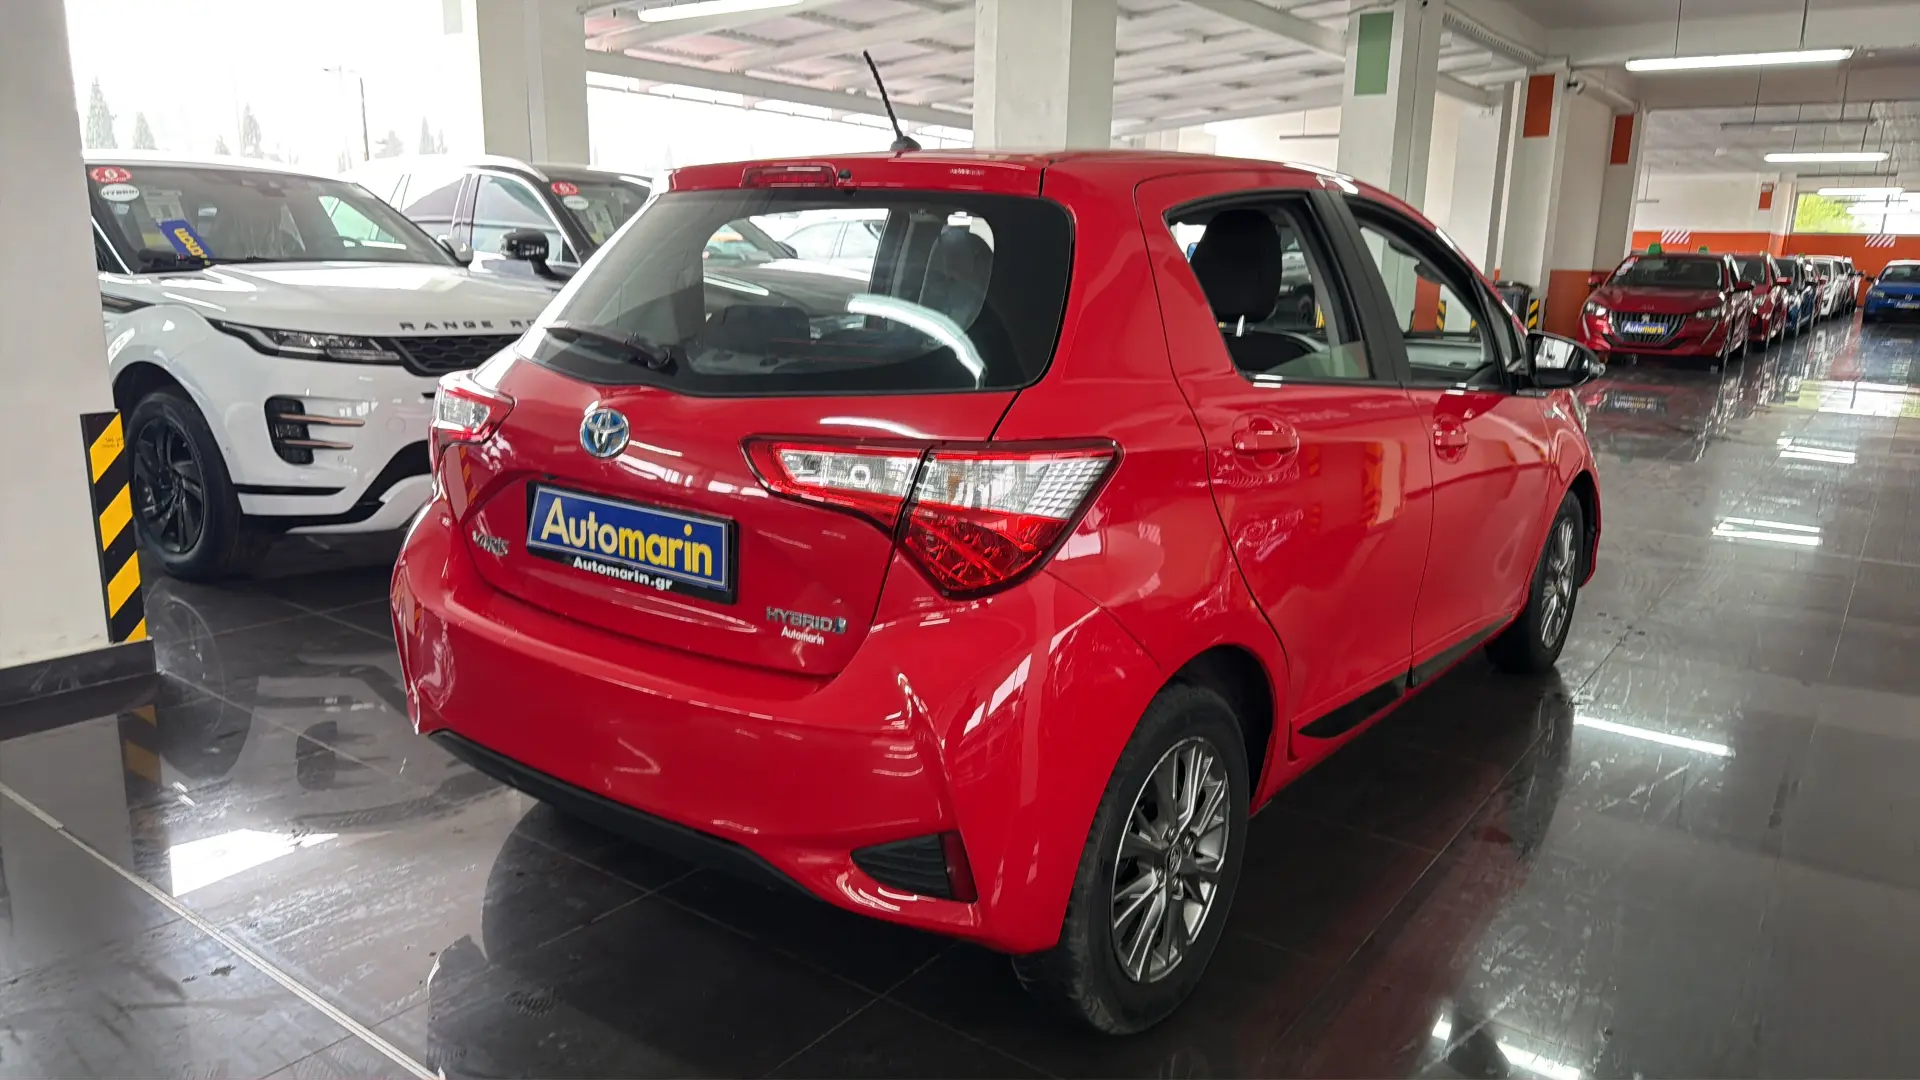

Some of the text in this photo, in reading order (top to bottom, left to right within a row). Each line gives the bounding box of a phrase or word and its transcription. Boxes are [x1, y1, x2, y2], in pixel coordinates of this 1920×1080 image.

[399, 320, 494, 331] RANGE
[540, 496, 712, 577] Automarin
[573, 556, 673, 592] Automarin.gr
[766, 606, 833, 634] HYBRID
[781, 625, 825, 646] Automarin
